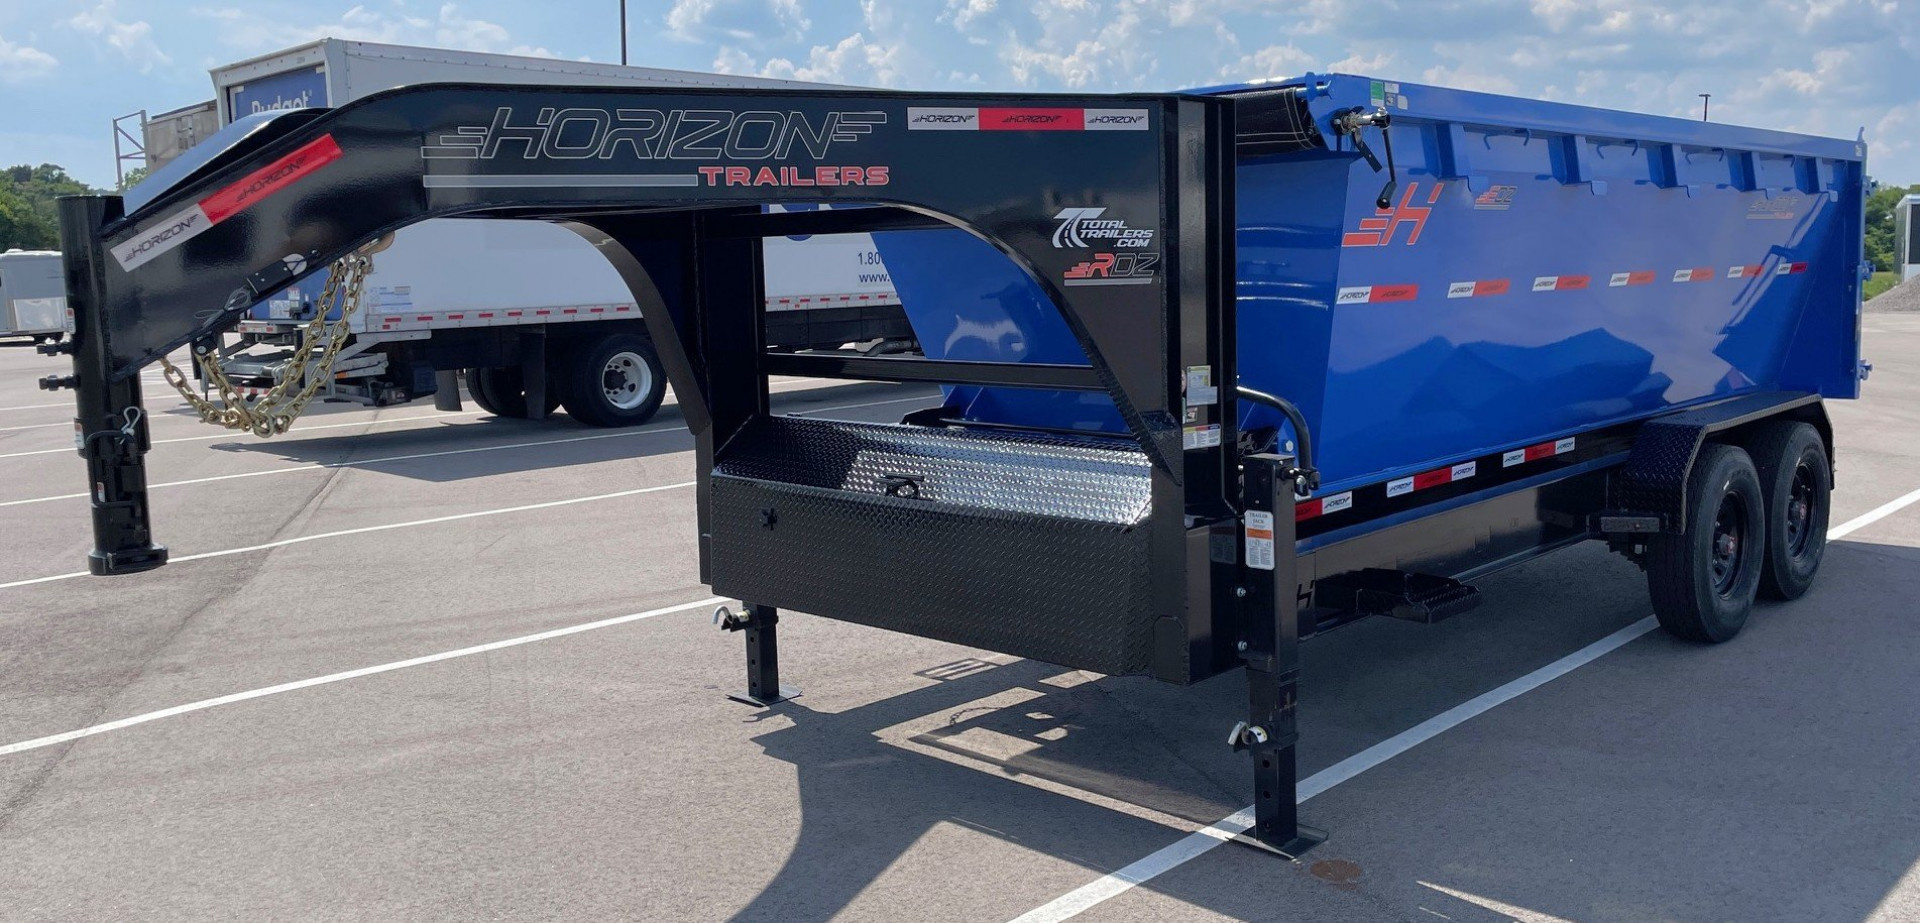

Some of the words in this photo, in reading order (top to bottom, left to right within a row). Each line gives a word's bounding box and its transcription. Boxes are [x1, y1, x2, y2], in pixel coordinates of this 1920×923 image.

[912, 114, 974, 123] HORIZON
[1002, 114, 1062, 123] HORIZON
[1088, 115, 1143, 124] HORIZON
[435, 107, 887, 160] HORIZON
[698, 166, 890, 187] TRAILERS
[125, 214, 199, 261] HORIZON
[237, 155, 306, 202] HORIZON
[1081, 220, 1128, 229] TOTAL
[1080, 229, 1154, 238] TRAILERS
[1113, 238, 1150, 248] .COM
[1075, 253, 1159, 277] RDZ
[859, 274, 890, 283] www.
